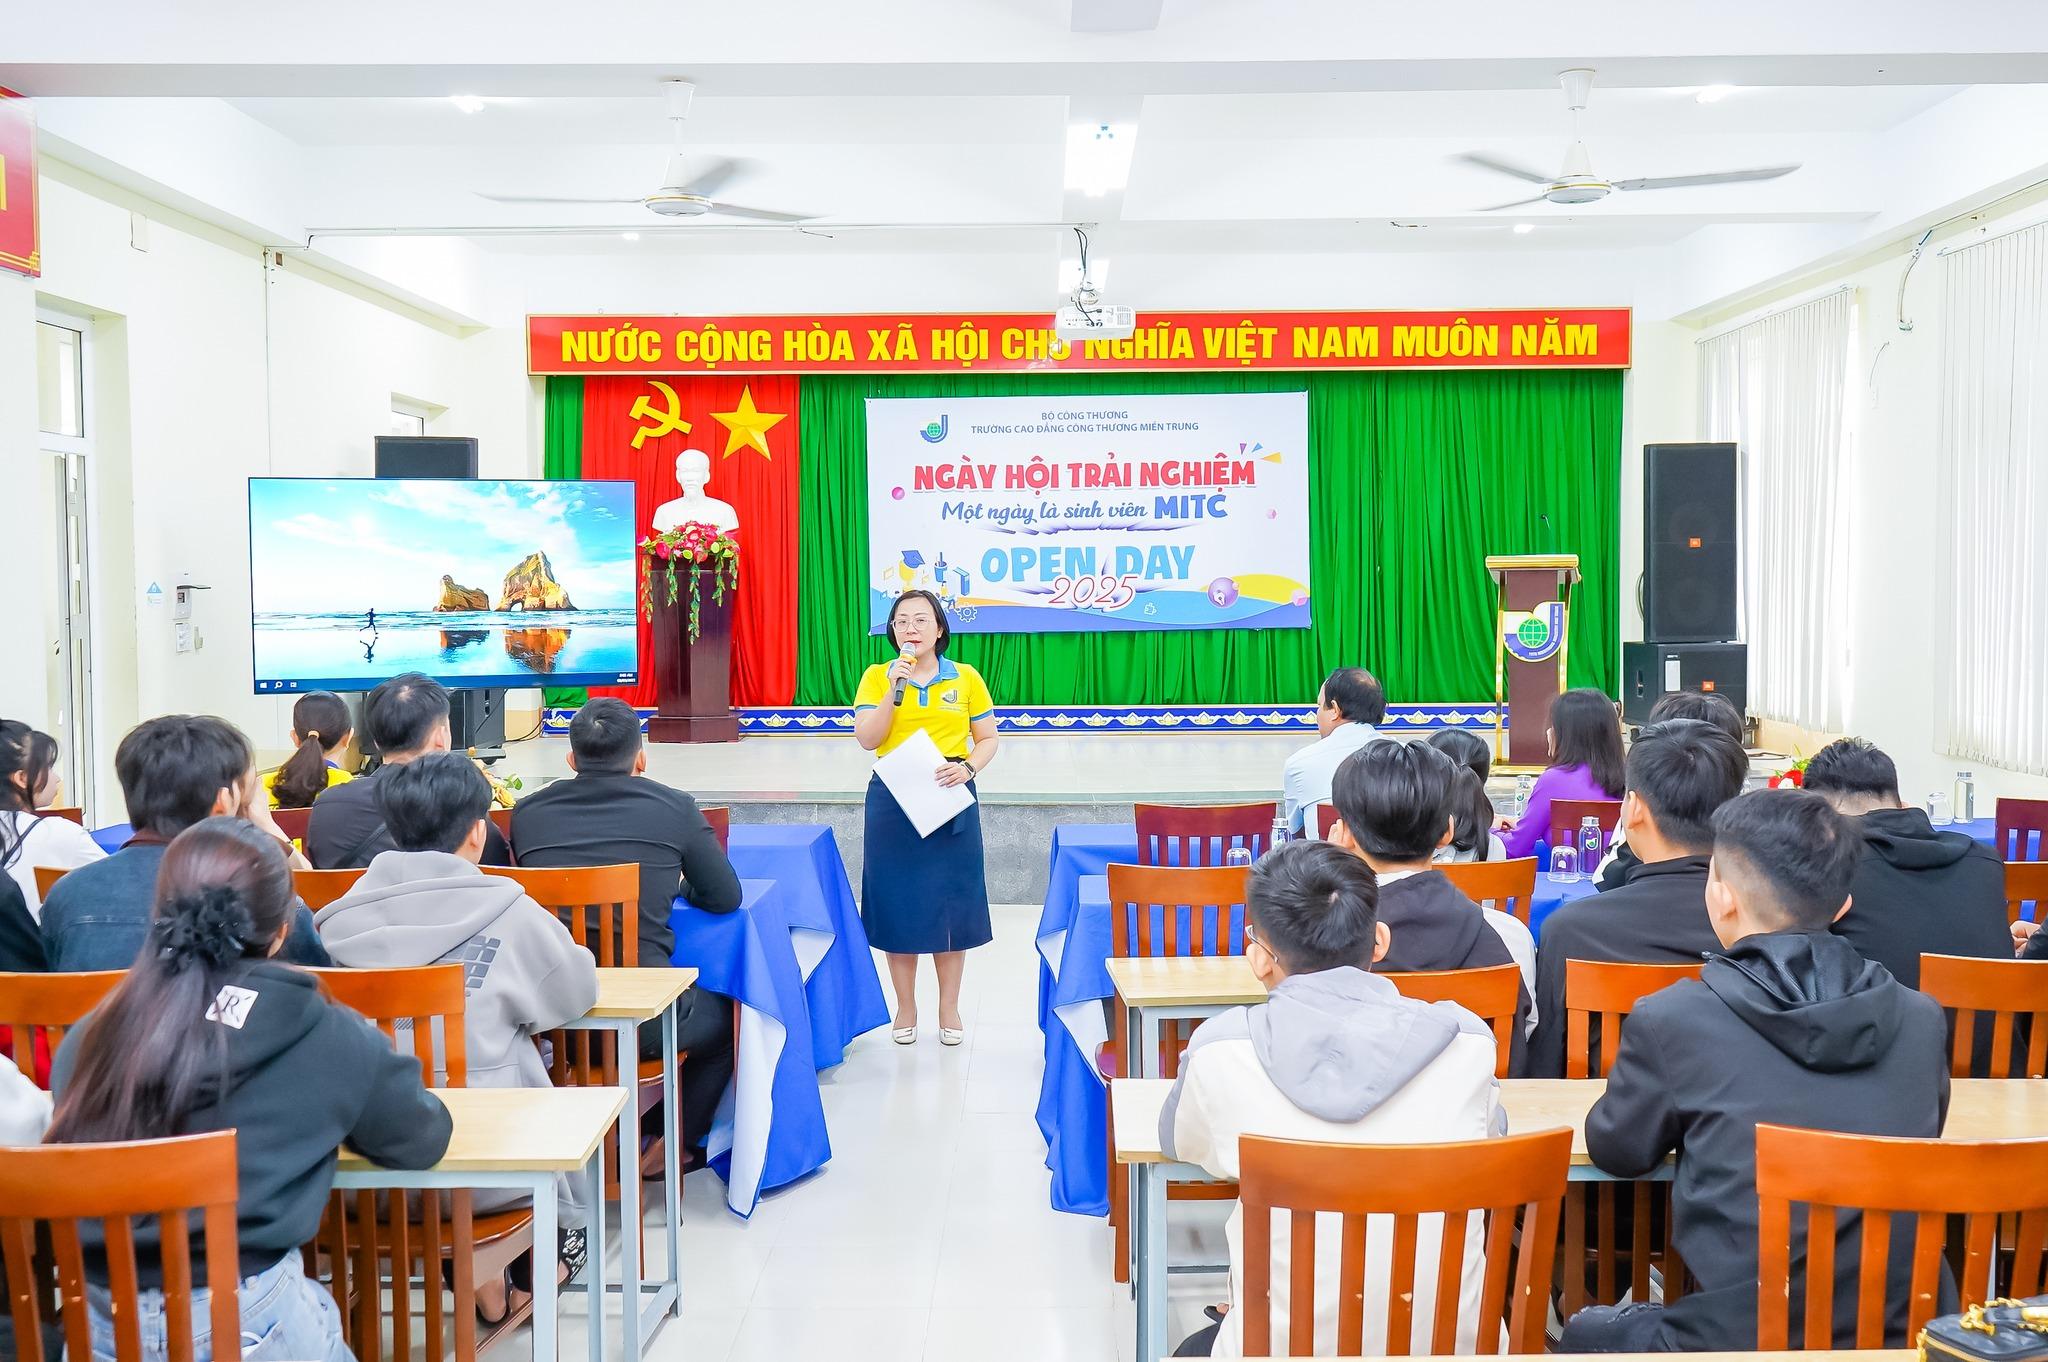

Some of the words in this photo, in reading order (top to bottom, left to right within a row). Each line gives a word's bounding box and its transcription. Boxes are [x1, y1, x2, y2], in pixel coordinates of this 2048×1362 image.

[561, 322, 662, 363] NƯỚC
[676, 323, 773, 369] CỘNG
[783, 322, 856, 362] HÒA
[867, 322, 919, 361] XÃ
[931, 321, 989, 367] HỘI
[1084, 321, 1195, 360] NGHĨA
[1202, 319, 1278, 365] VIỆT
[1293, 326, 1379, 358] NAM
[1392, 317, 1499, 358] MUÔN
[1511, 316, 1598, 356] NĂM
[1014, 425, 1034, 433] CAO
[1166, 422, 1199, 431] TRUNG
[914, 454, 997, 490] NGÀY
[1005, 455, 1059, 496] HỘI
[1067, 452, 1132, 488] TRẢI
[1140, 452, 1255, 493] NGHIỆM
[941, 501, 983, 524] Một
[987, 503, 1037, 526] ngày
[1039, 501, 1060, 519] là
[1063, 500, 1104, 518] sinh
[1108, 502, 1148, 518] viên
[1154, 494, 1228, 519] MITC
[980, 546, 1096, 582] OPEN
[1115, 545, 1195, 580] DAY
[1048, 576, 1138, 608] 2025
